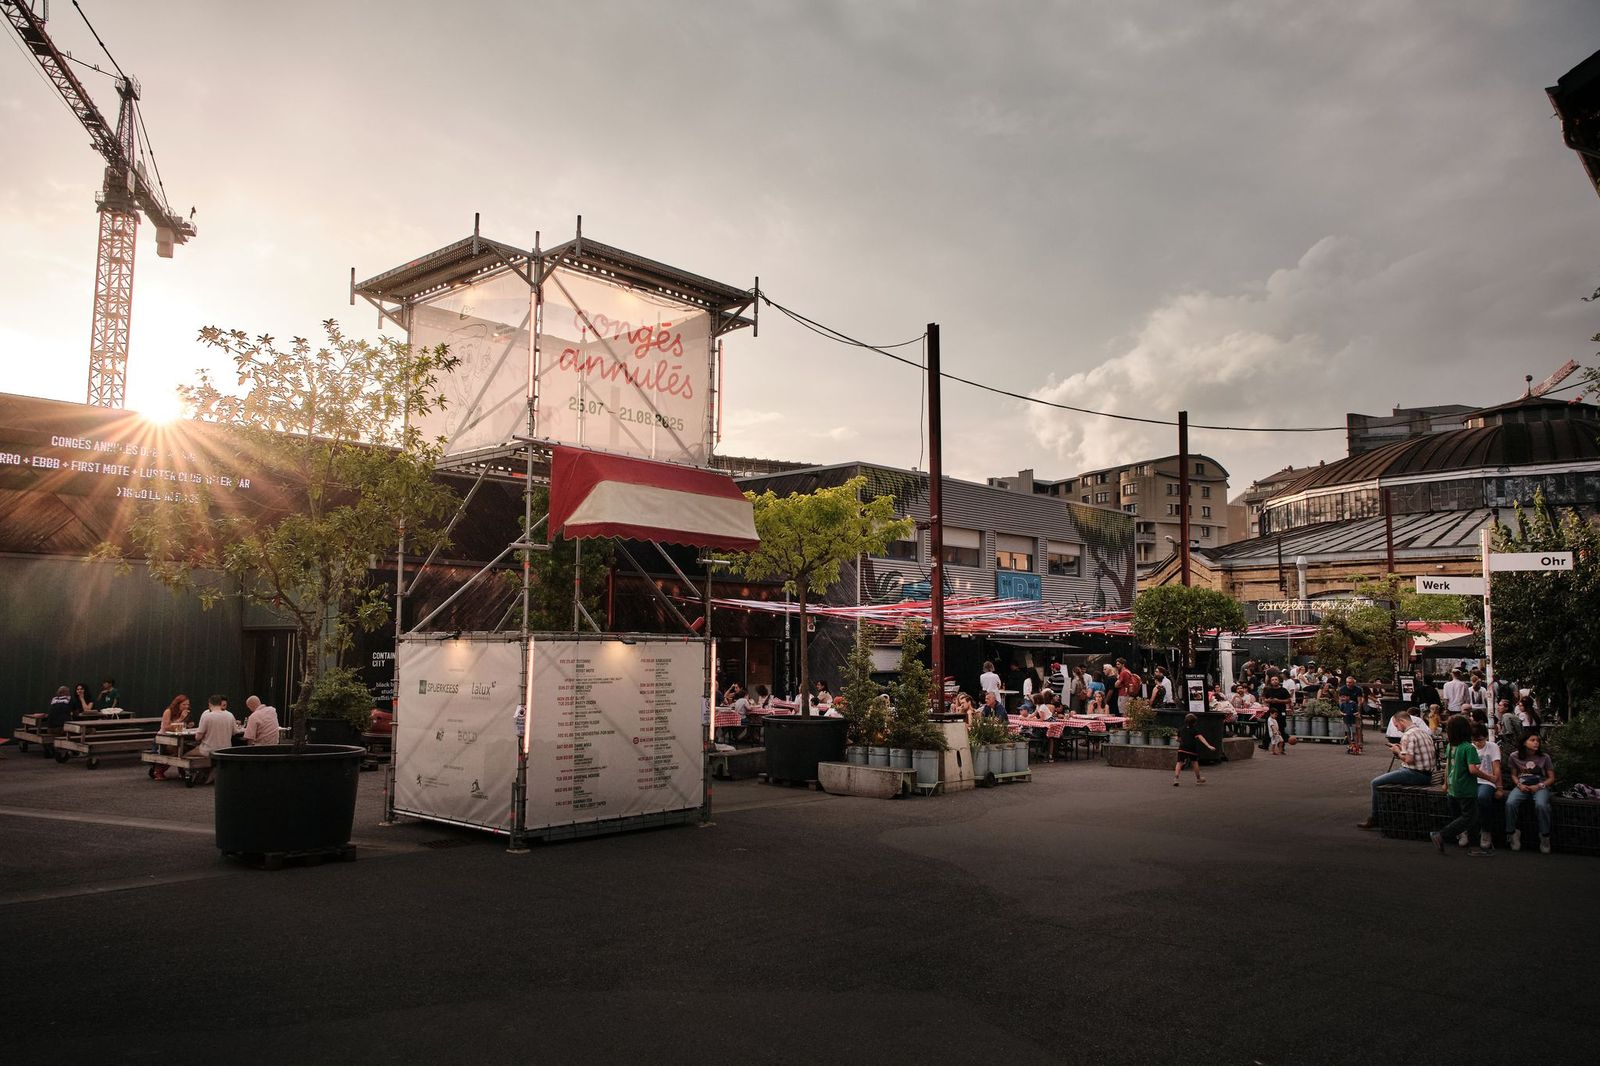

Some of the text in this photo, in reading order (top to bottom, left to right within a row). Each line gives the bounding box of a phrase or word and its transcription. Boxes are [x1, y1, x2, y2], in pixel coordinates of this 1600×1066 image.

[32, 456, 60, 469] EBBB
[71, 461, 101, 473] FIRST
[102, 464, 130, 476] MOTE
[1540, 557, 1567, 566] Ohr
[1422, 580, 1451, 591] Werk
[372, 660, 386, 668] CITY
[471, 682, 492, 695] lalux
